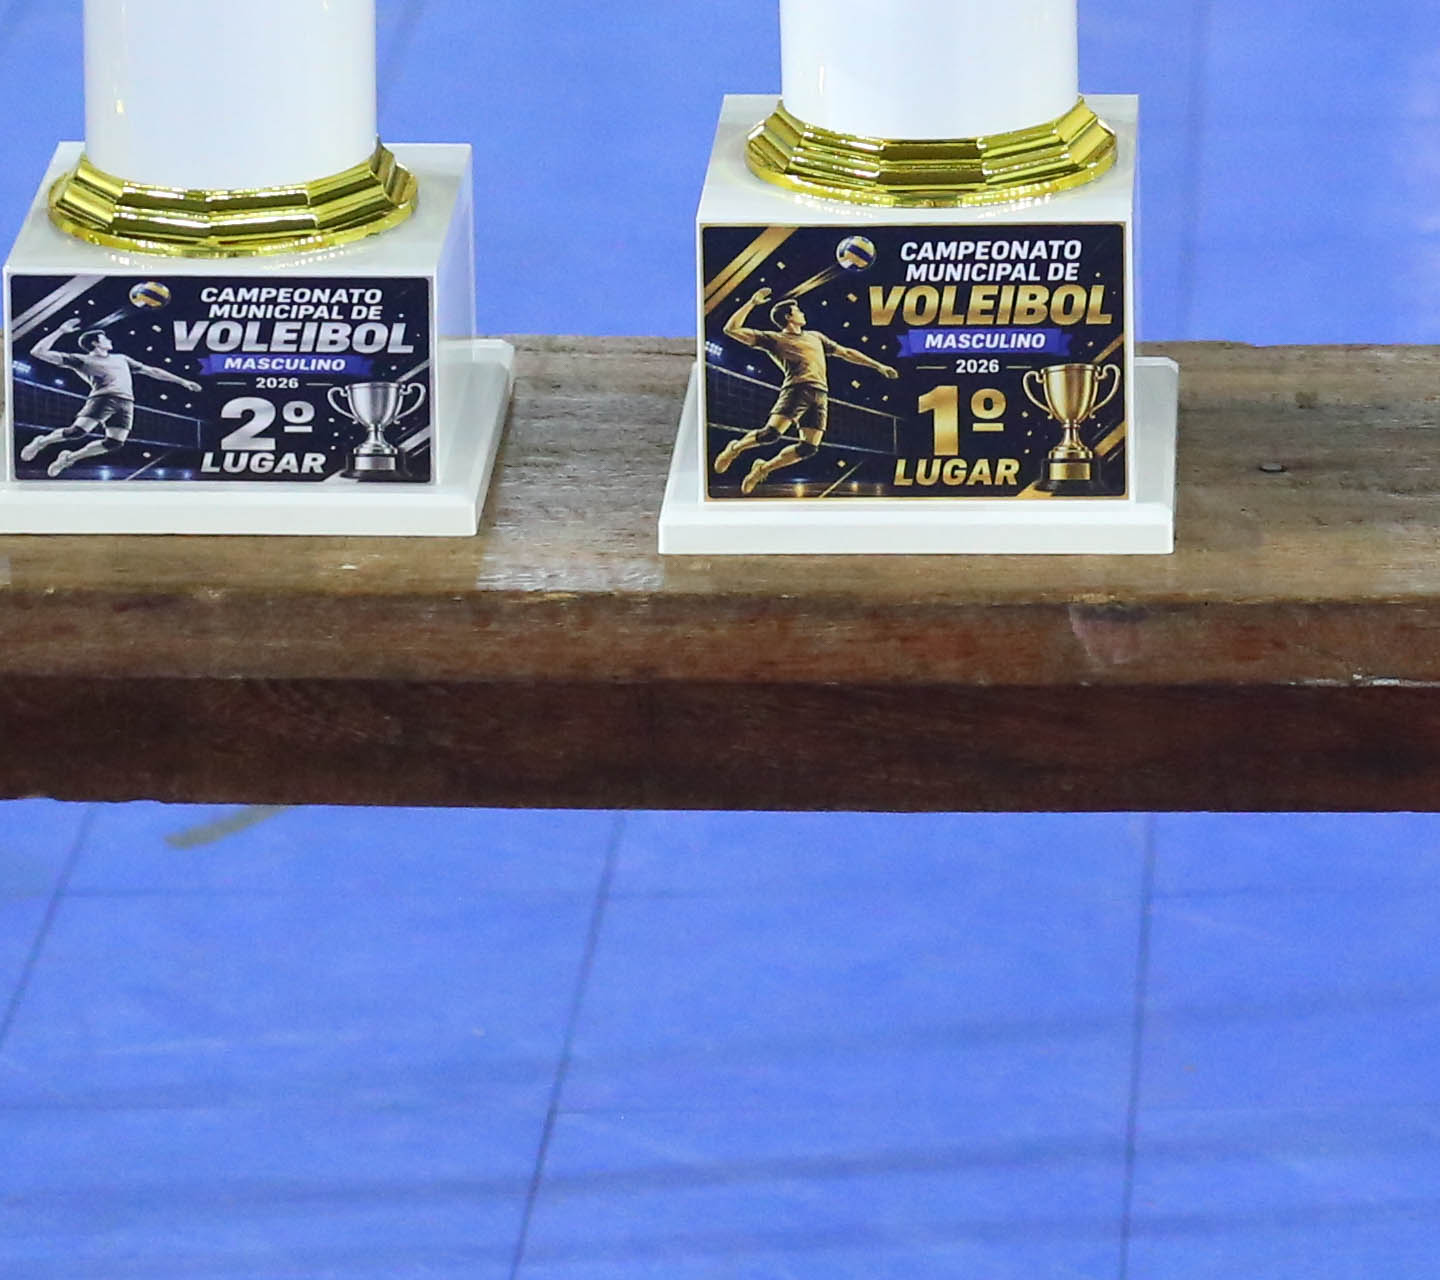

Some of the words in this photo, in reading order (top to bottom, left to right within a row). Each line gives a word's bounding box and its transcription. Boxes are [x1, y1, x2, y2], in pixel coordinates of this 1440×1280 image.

[900, 240, 1082, 262] CAMPEONATO
[906, 262, 1042, 282] MUNICIPAL
[1047, 263, 1079, 281] DE
[200, 287, 382, 304] CAMPEONATO
[209, 304, 346, 320] MUNICIPAL
[350, 305, 382, 320] DE
[869, 284, 1112, 327] VOLEIBOL
[173, 320, 414, 354] VOLEIBOL
[925, 333, 1046, 350] MASCULINO
[224, 357, 345, 372] MASCULINO
[956, 358, 1000, 374] 2026
[256, 377, 299, 389] 2026
[200, 452, 325, 474] LUGAR
[894, 458, 1020, 486] LUGAR
